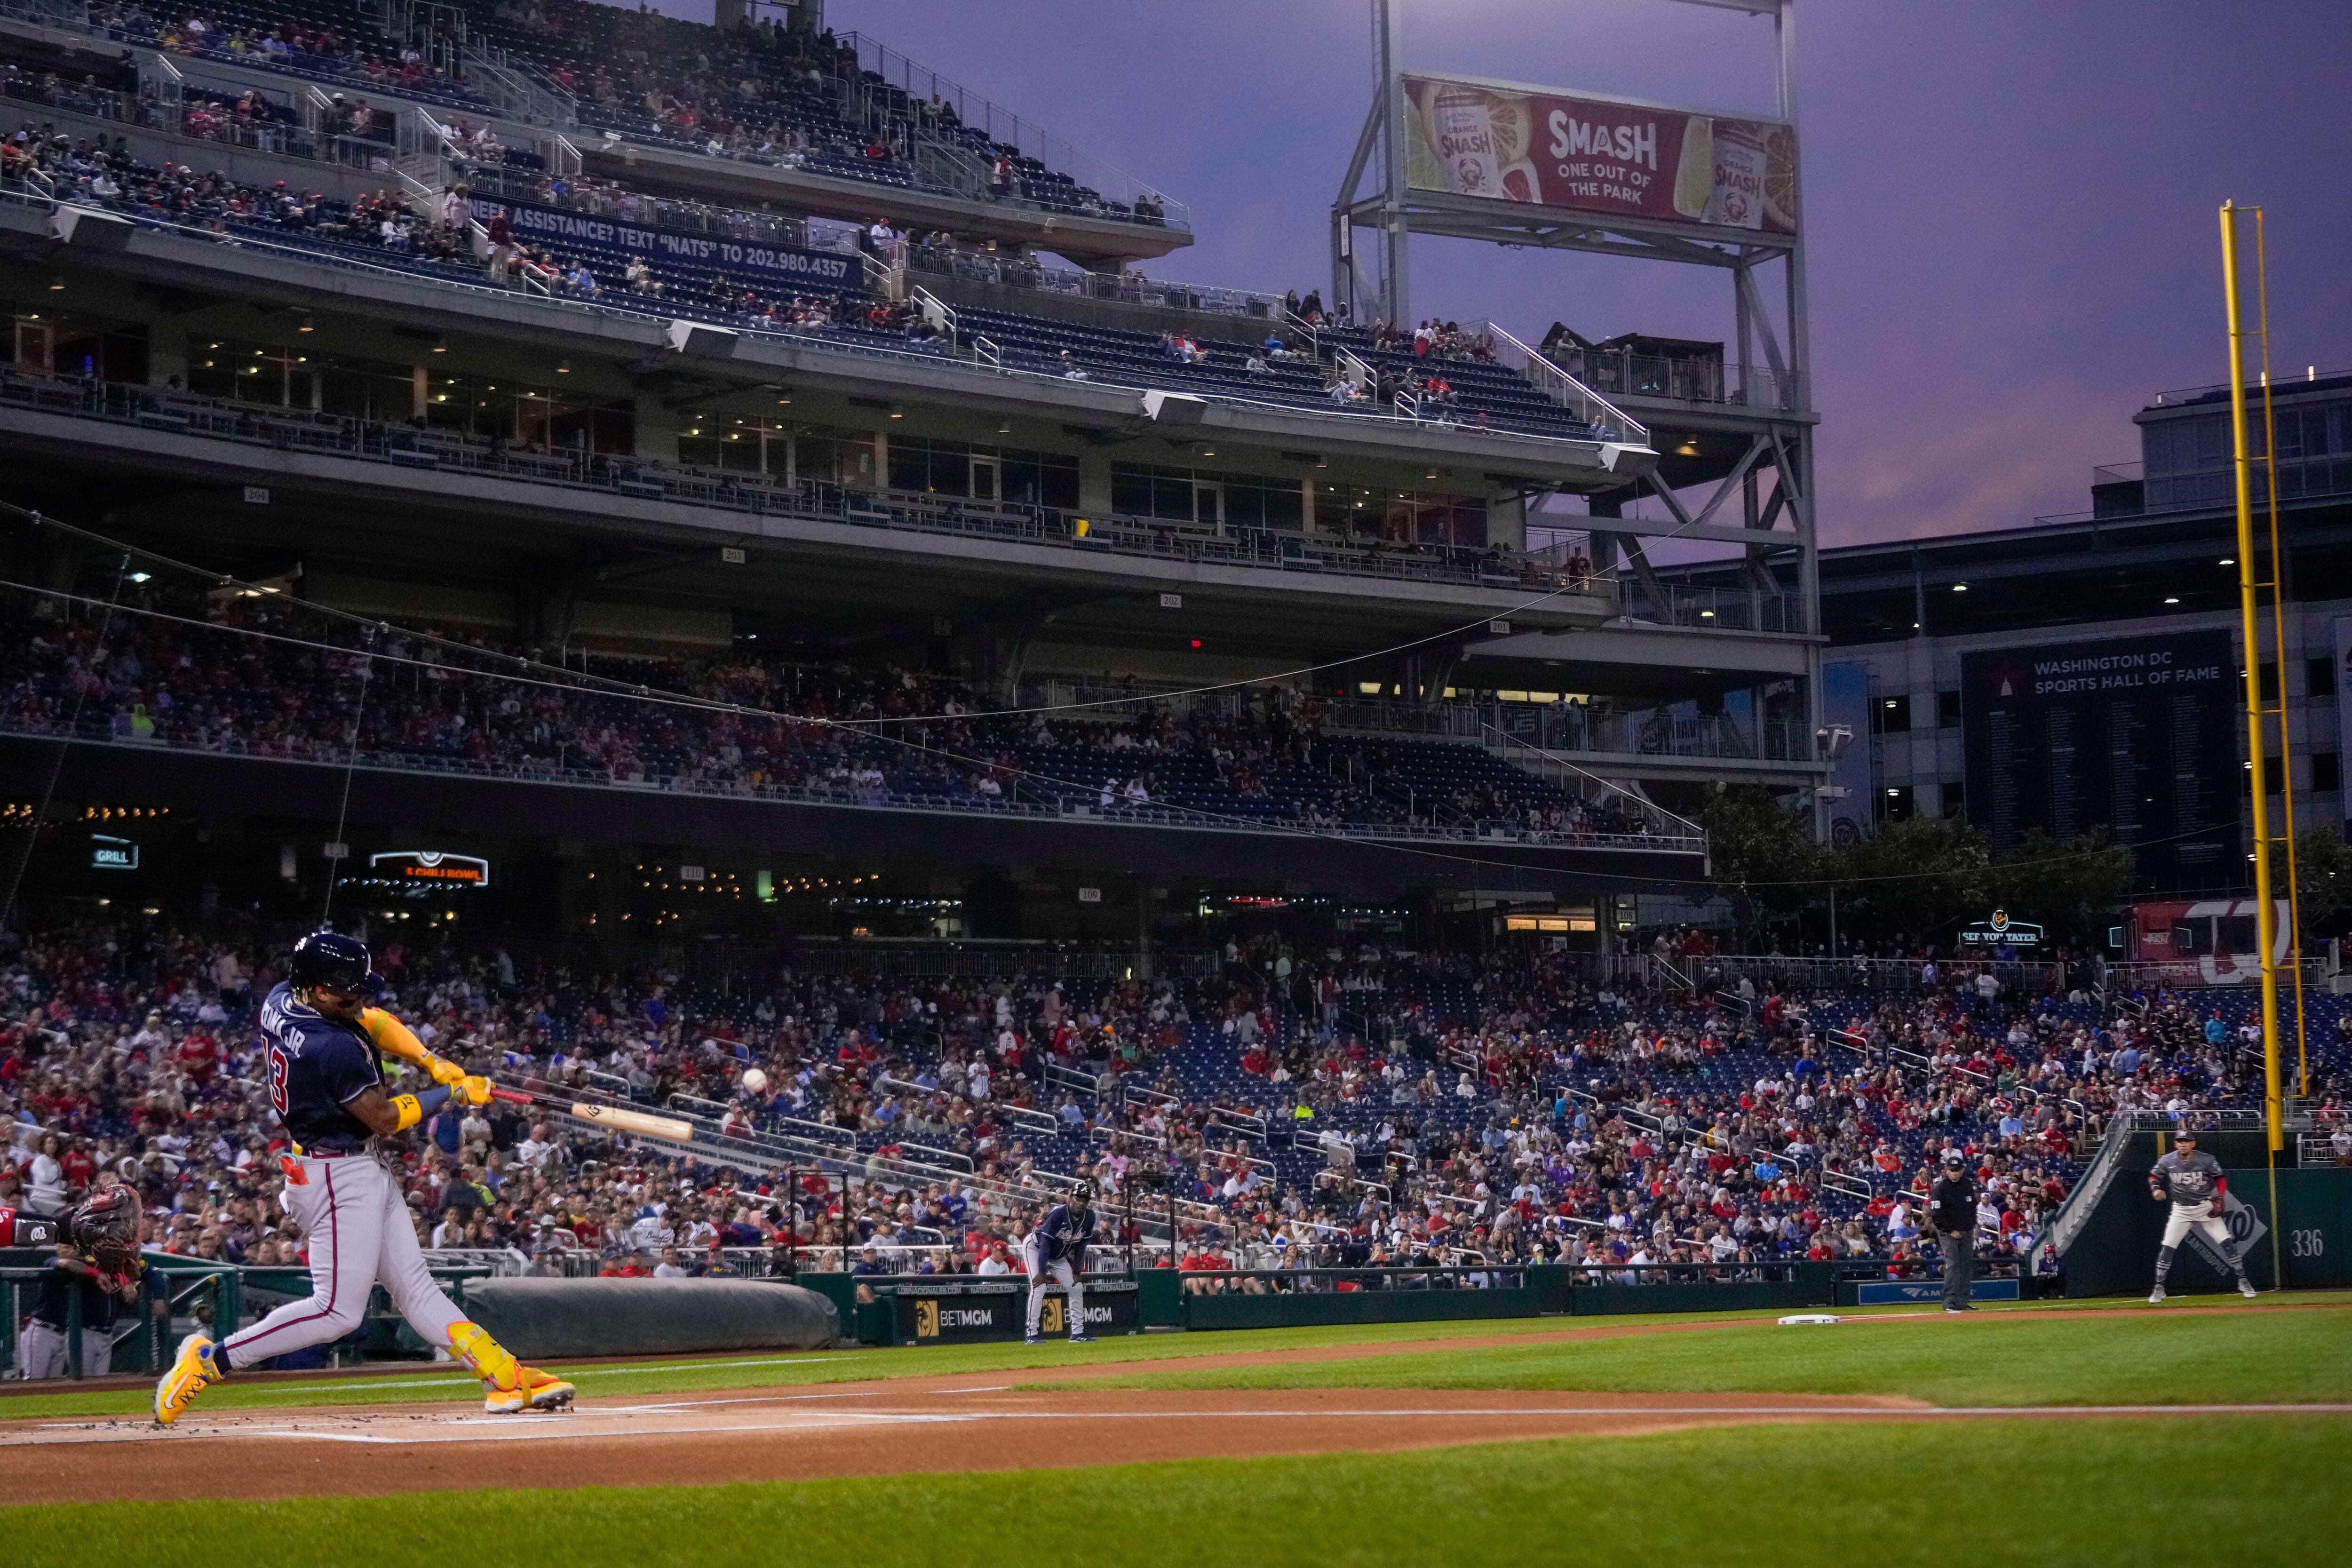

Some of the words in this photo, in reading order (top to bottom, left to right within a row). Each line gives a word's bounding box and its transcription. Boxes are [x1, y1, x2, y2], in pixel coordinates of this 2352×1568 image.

[1441, 132, 1492, 159] SMASH
[1549, 110, 1657, 171] SMASH
[1558, 163, 1590, 178] ONE
[1594, 164, 1627, 181] OUT
[1630, 171, 1652, 188] OF
[1715, 163, 1761, 199] SMASH
[1569, 182, 1599, 196] THE
[1603, 183, 1643, 205] PARK
[513, 207, 614, 242] ASSISTANCE?
[618, 227, 656, 250] TEXT
[721, 244, 743, 263] TO
[747, 247, 847, 278] 202.980.4357
[1164, 596, 1178, 605] 202
[1493, 623, 1506, 632] 201
[2034, 654, 2145, 675] WASHINGTON
[2150, 652, 2172, 666] DC
[2035, 677, 2096, 694] SPORTS
[2101, 674, 2144, 689] HALL
[2148, 671, 2171, 685] OF
[2176, 666, 2221, 682] FAME
[95, 849, 129, 863] GRILL
[2169, 1171, 2205, 1186] WSH
[1931, 1200, 1941, 1210] 72
[2292, 1229, 2324, 1257] 336
[1095, 1281, 1139, 1292] NATIONALS.COM
[940, 1309, 993, 1327] BETMGM
[1064, 1306, 1112, 1323] BMGM
